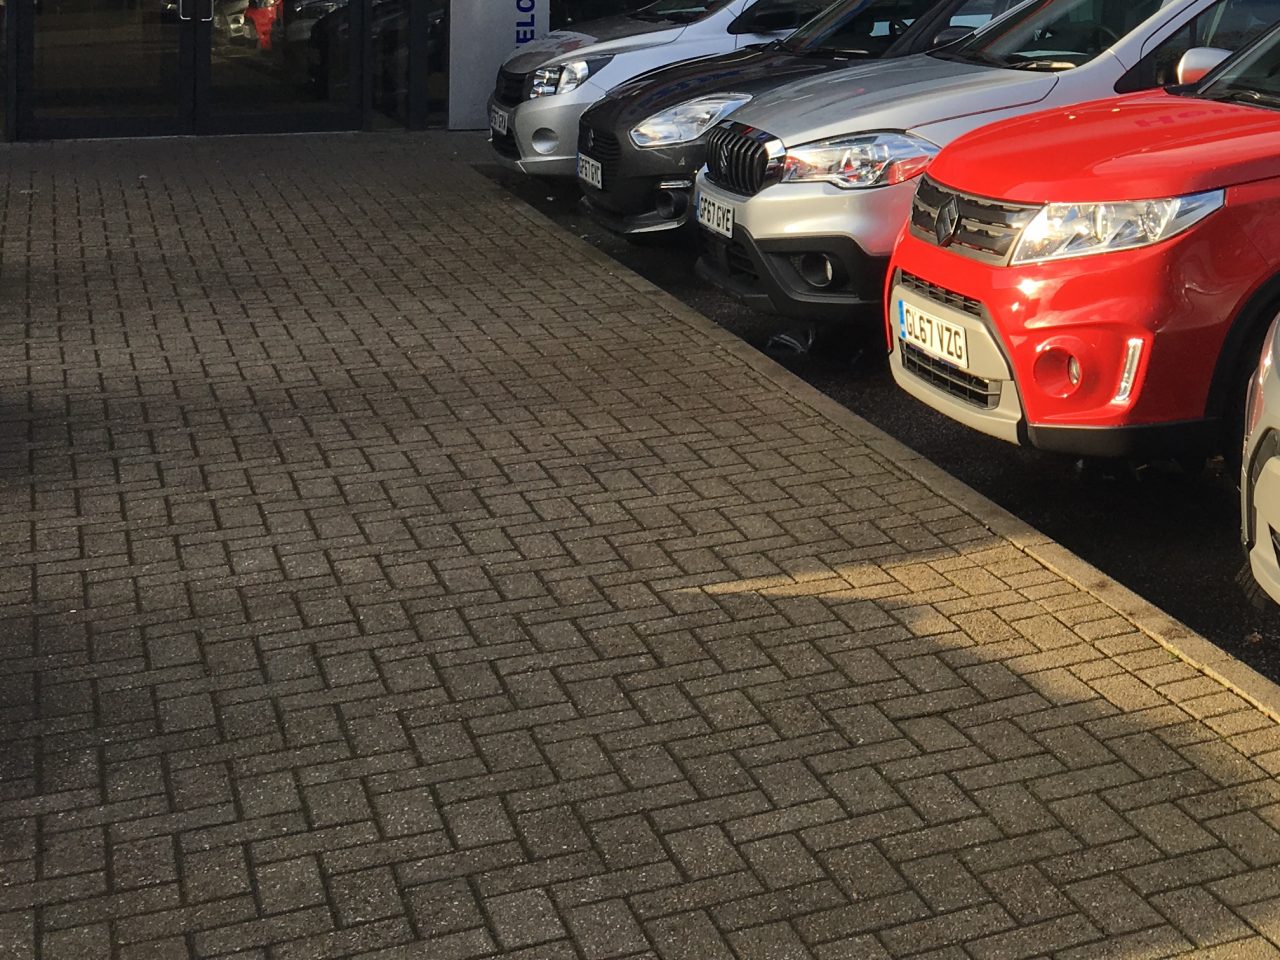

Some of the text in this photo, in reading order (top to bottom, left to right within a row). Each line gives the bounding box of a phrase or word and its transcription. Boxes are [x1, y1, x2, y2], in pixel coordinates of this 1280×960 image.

[716, 205, 731, 232] GYE
[905, 308, 963, 360] GL67 VZG
